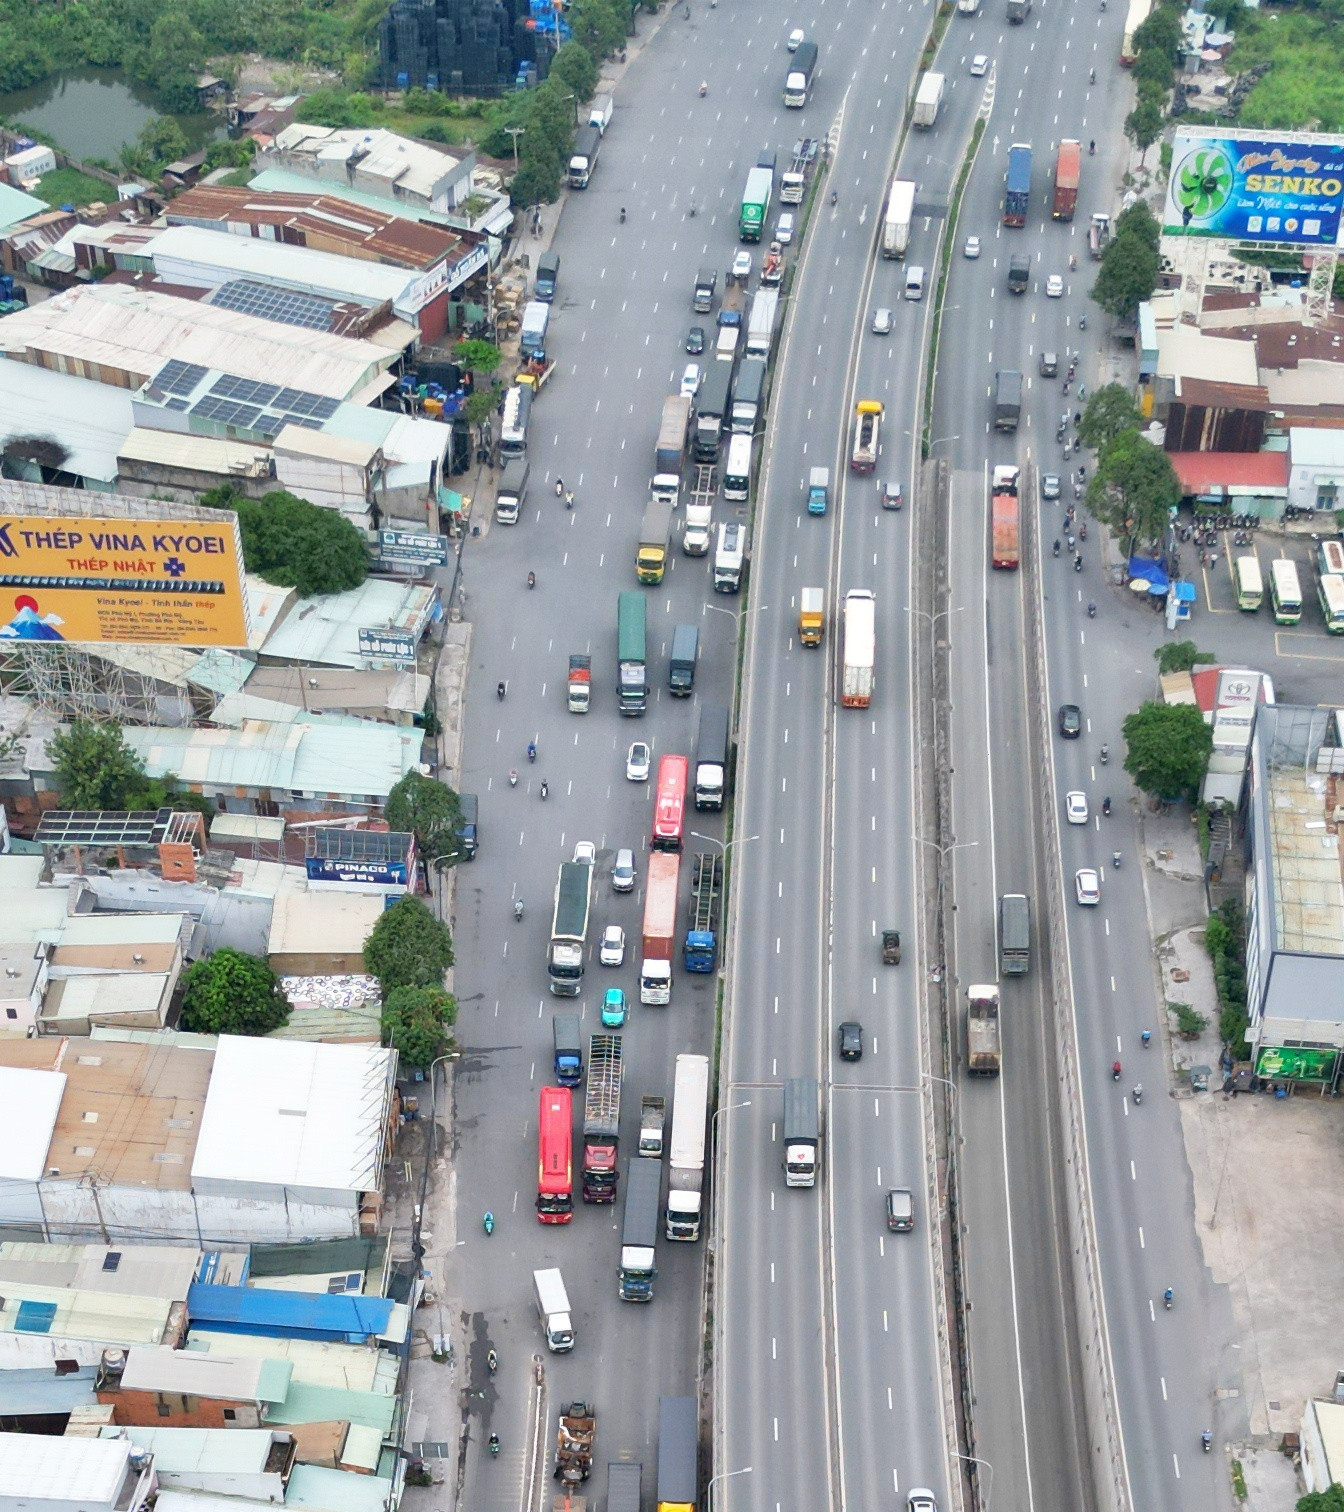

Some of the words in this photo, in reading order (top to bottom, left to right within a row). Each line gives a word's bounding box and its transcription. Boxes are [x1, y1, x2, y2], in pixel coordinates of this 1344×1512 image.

[1245, 174, 1342, 196] SENKO
[20, 527, 83, 549] THÉP
[89, 532, 146, 551] VINA
[153, 535, 226, 554] KYOEI
[66, 554, 109, 571] THÉP
[113, 557, 156, 576] NHẬT
[335, 863, 387, 873] PINACO
